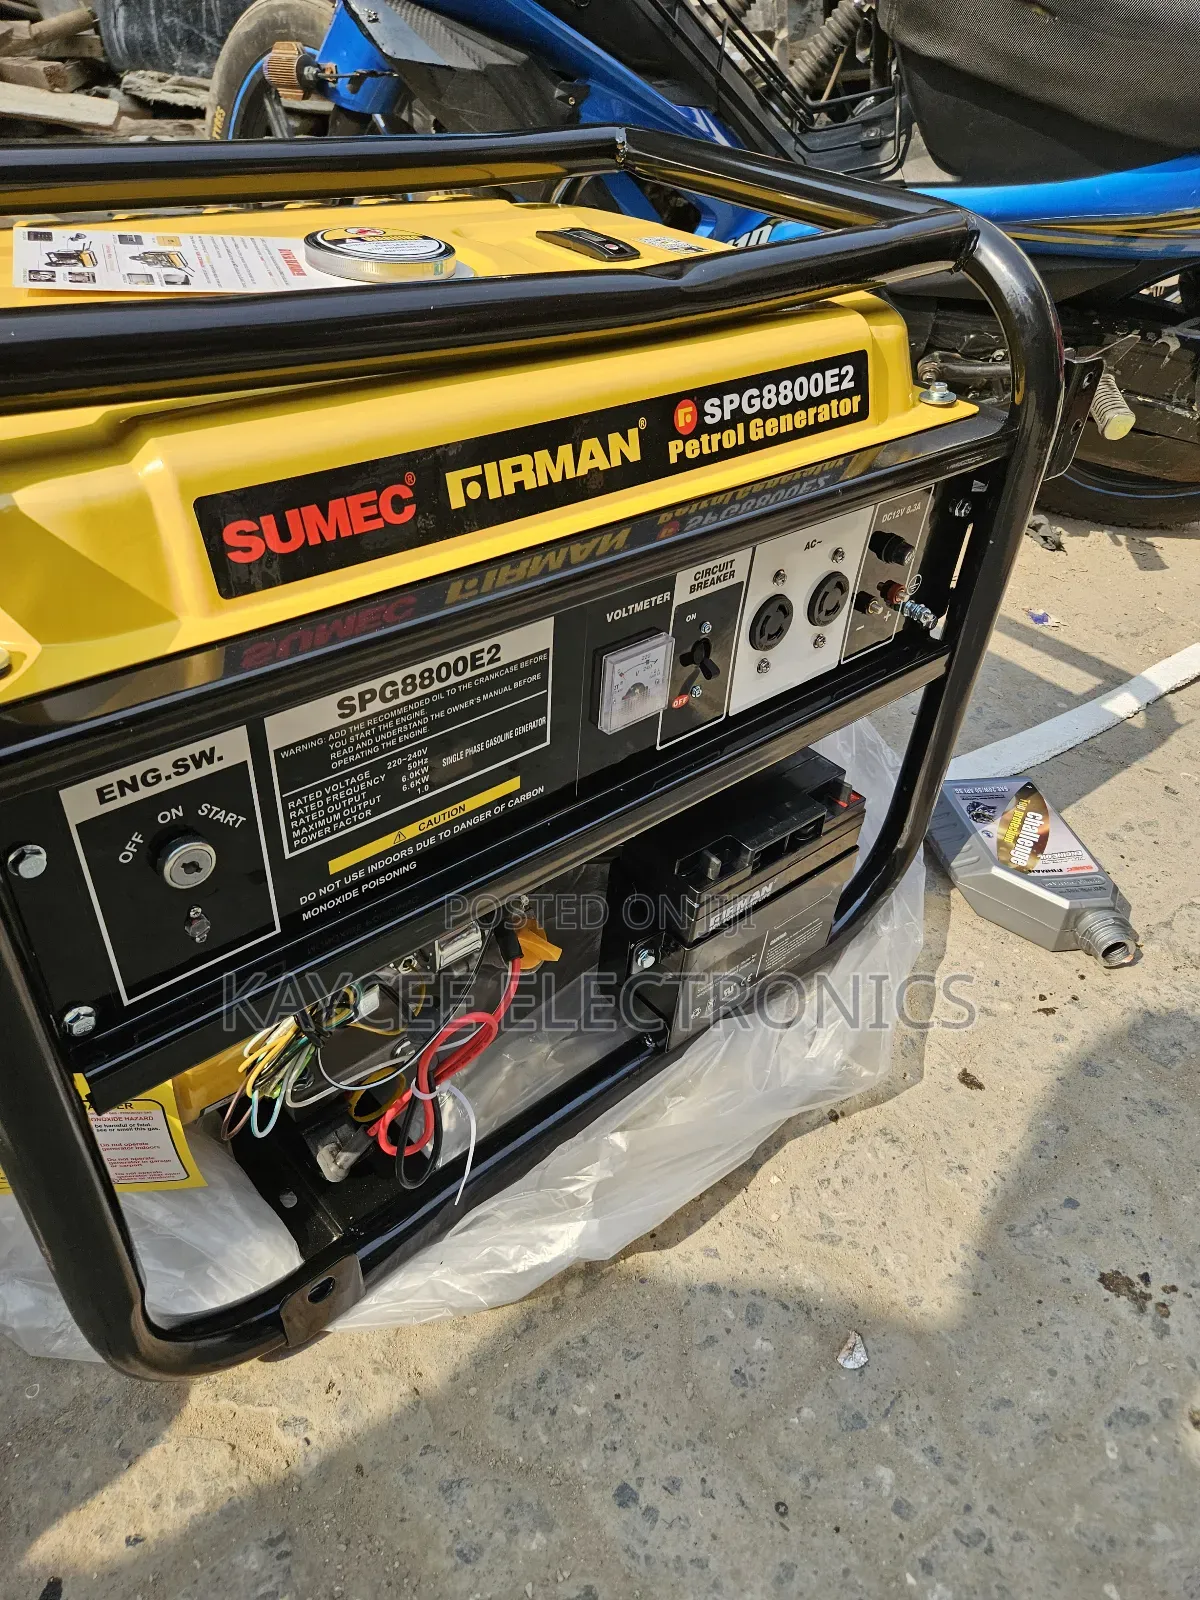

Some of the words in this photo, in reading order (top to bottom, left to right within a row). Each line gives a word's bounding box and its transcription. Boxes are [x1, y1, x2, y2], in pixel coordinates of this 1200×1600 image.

[703, 364, 855, 424] SPG8800E2
[668, 422, 745, 464] Petrol
[749, 394, 861, 442] Generator
[882, 507, 905, 523] DC12V
[689, 570, 736, 595] BREAKER
[693, 559, 735, 582] CIRCUIT
[606, 591, 671, 623] VOLTMETER
[685, 613, 697, 623] ON
[336, 643, 501, 720] SPG8800E2
[672, 695, 688, 708] OFF
[280, 737, 326, 759] WARNING:
[328, 729, 347, 742] ADD
[348, 721, 366, 733] THE
[367, 698, 430, 727] RECOMMENDED
[431, 693, 445, 702] OIL
[446, 688, 457, 697] TO
[458, 681, 473, 692] THE
[474, 663, 519, 686] CRANKCASE
[519, 653, 548, 669] BEFORE
[329, 739, 348, 751] YOU
[349, 727, 376, 743] START
[377, 721, 394, 733] THE
[395, 708, 428, 725] ENGINE.
[330, 747, 354, 760] READ
[355, 738, 374, 751] AND
[375, 716, 429, 743] UNDERSTAND
[430, 710, 445, 721] THE
[482, 685, 512, 701] MANUAL
[513, 672, 542, 689] BEFORE
[331, 745, 380, 770] OPERATING
[381, 738, 397, 750] THE
[398, 726, 430, 743] ENGINE.
[442, 750, 464, 767] SINGLE
[464, 742, 485, 759] PHASE
[485, 730, 514, 749] GASOLINE
[514, 716, 547, 737] GENERATOR
[95, 746, 224, 806] ENG.SW.
[288, 790, 323, 810] RATED
[324, 770, 371, 795] VOLTAGE
[289, 800, 324, 819] RATED
[326, 773, 386, 805] FREQUENCY
[407, 757, 429, 771] 50Hz
[291, 809, 325, 829] RATED
[327, 791, 367, 814] OUTPUT
[401, 766, 429, 783] 6.0KW
[157, 805, 184, 824] ON
[197, 803, 247, 829] START
[292, 812, 341, 839] MAXIMUM
[342, 795, 382, 817] OUTPUT
[402, 775, 430, 792] 6.6KW
[293, 826, 331, 848] POWER
[333, 809, 372, 831] FACTOR
[417, 784, 430, 795] 1.0
[418, 803, 466, 832] CAUTION
[118, 831, 144, 864] OFF
[299, 891, 317, 905] DO
[319, 879, 342, 897] NOT
[344, 868, 366, 885] USE
[367, 846, 414, 874] INDOORS
[416, 835, 437, 852] DUE
[438, 829, 451, 841] TO
[453, 810, 492, 834] DANGER
[493, 803, 506, 815] OF
[507, 785, 545, 808] CARBON
[301, 888, 360, 921] MONOXIDE
[361, 861, 417, 893] POISONING
